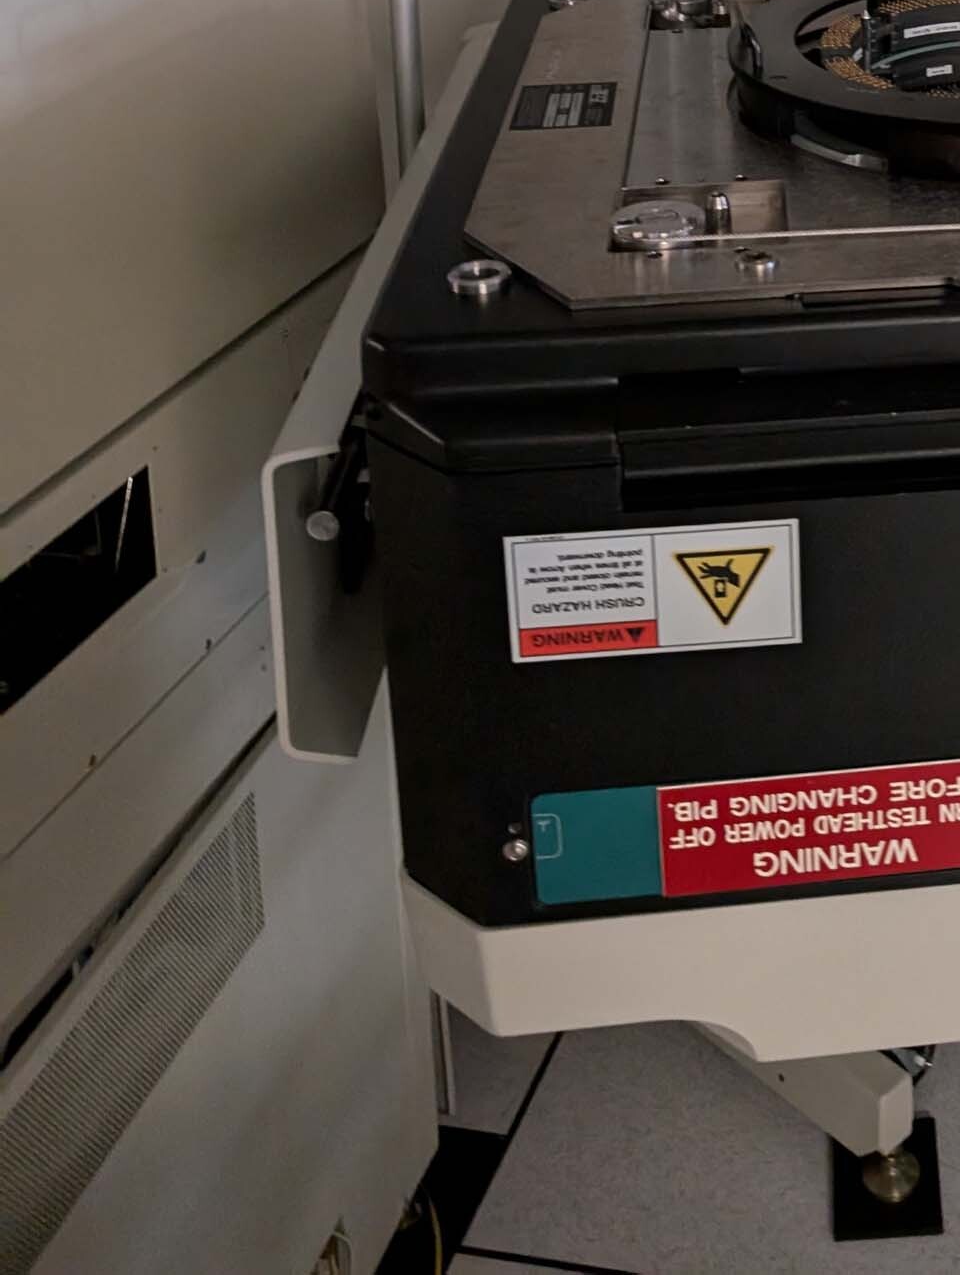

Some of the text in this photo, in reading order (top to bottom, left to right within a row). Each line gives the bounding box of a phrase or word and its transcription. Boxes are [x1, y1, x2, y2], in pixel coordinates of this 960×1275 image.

[606, 549, 643, 559] pointing
[546, 586, 570, 594] must
[572, 584, 598, 592] Cover
[600, 583, 623, 591] Head
[531, 597, 646, 614] CRUSH HAZARD
[532, 629, 624, 647] WARNING
[730, 783, 878, 815] CHANGING
[667, 799, 718, 822] PIB.
[814, 804, 929, 835] TESTHEAD
[724, 814, 804, 841] POWER
[669, 827, 716, 848] OFF
[752, 838, 918, 877] WARNING
